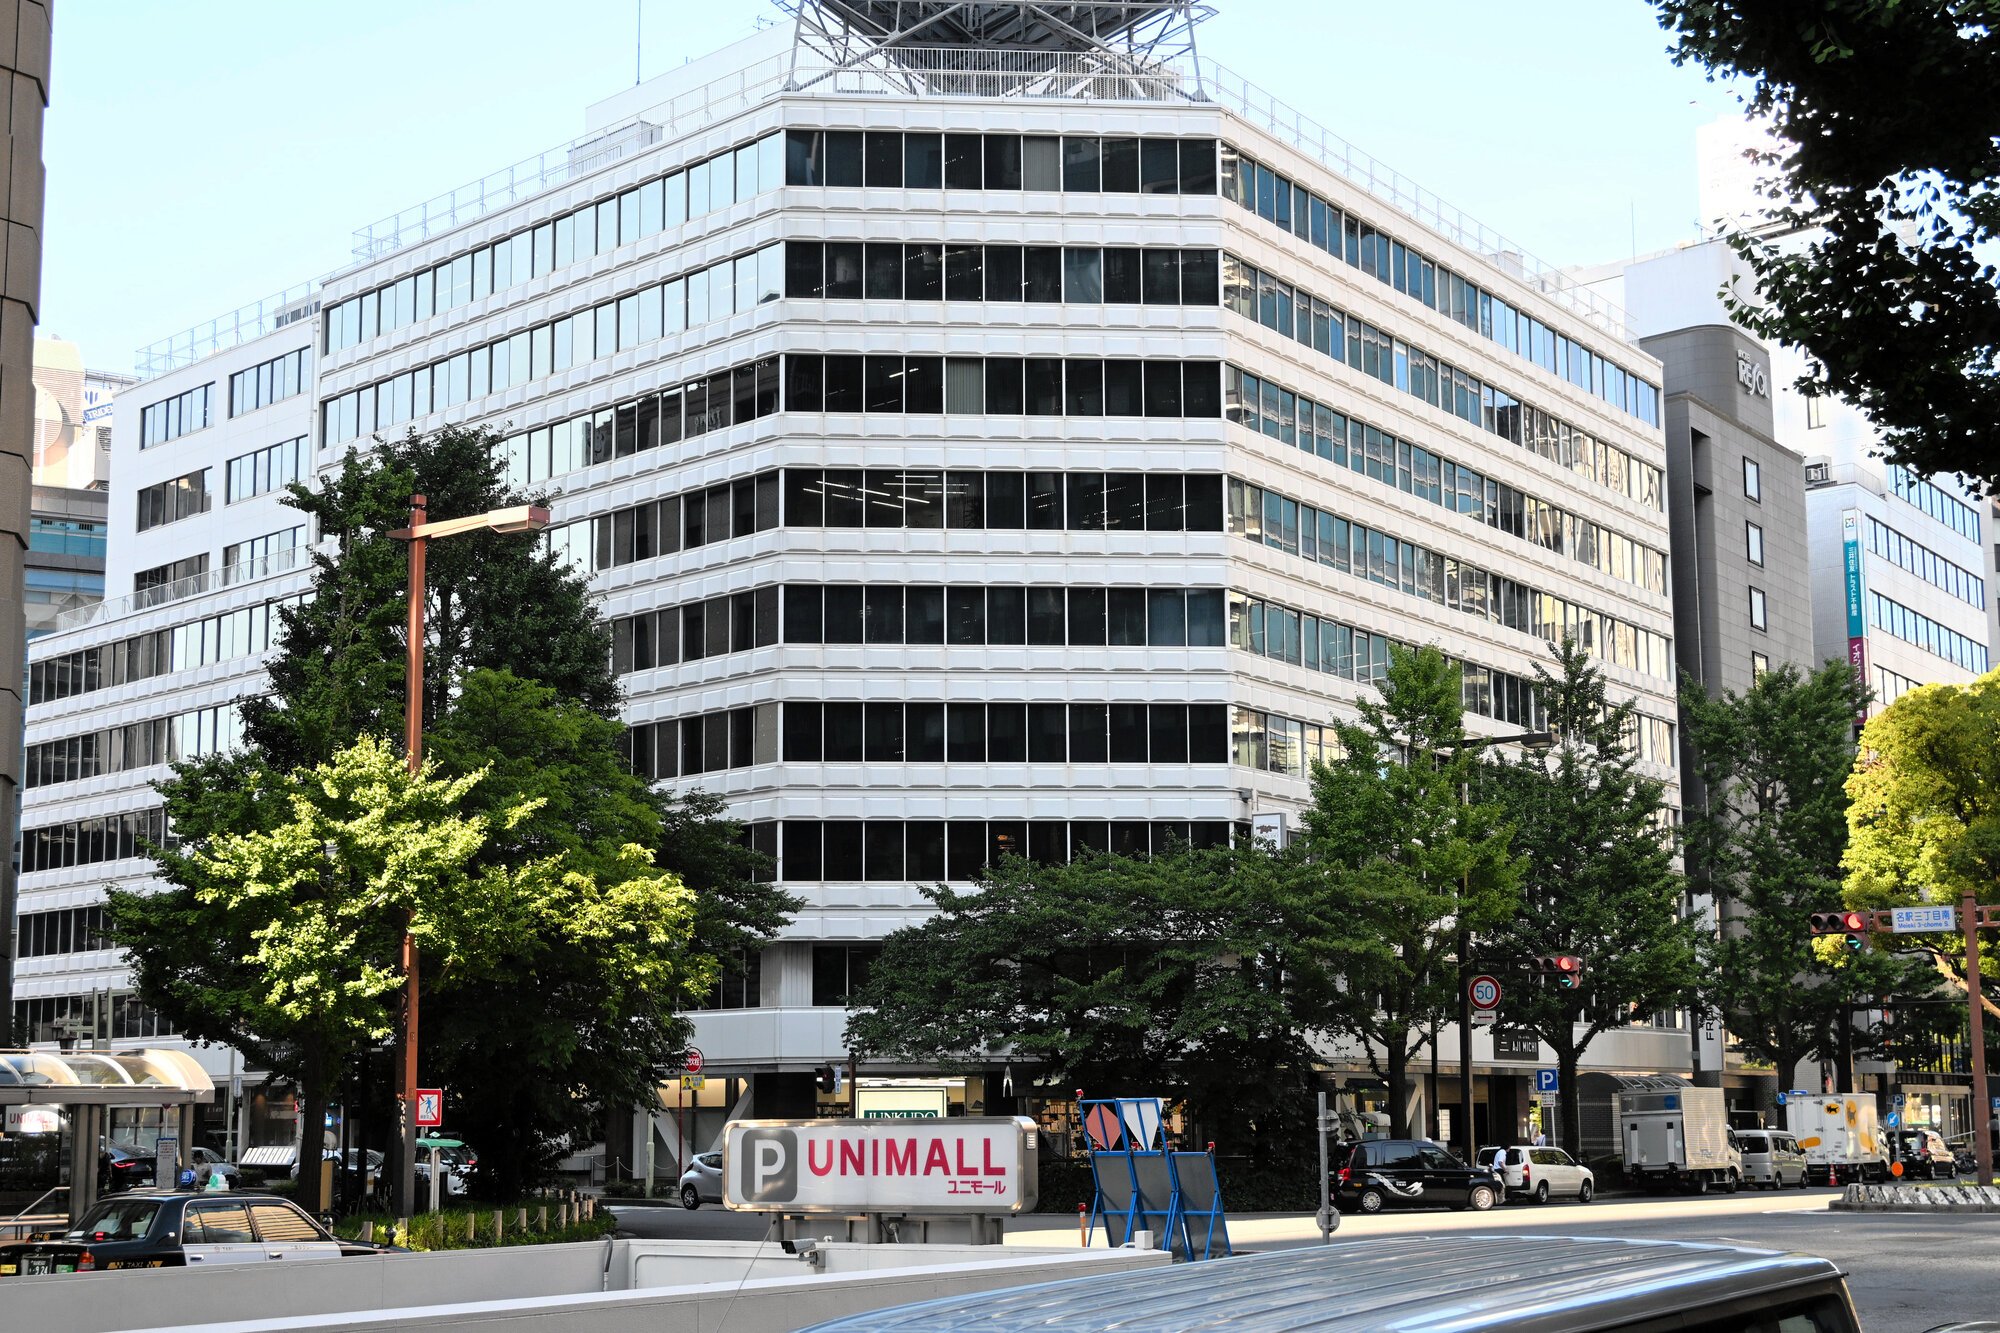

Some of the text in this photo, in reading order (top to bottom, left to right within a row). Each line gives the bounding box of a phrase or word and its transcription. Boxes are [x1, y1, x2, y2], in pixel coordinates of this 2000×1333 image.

[1896, 910, 1950, 922] 名駅三丁目南
[1476, 985, 1494, 1000] 50
[1512, 1041, 1537, 1053] AJI MICHI
[1542, 1071, 1554, 1089] P
[753, 1138, 1006, 1194] P UNIMALL
[947, 1180, 1006, 1194] ユニモール
